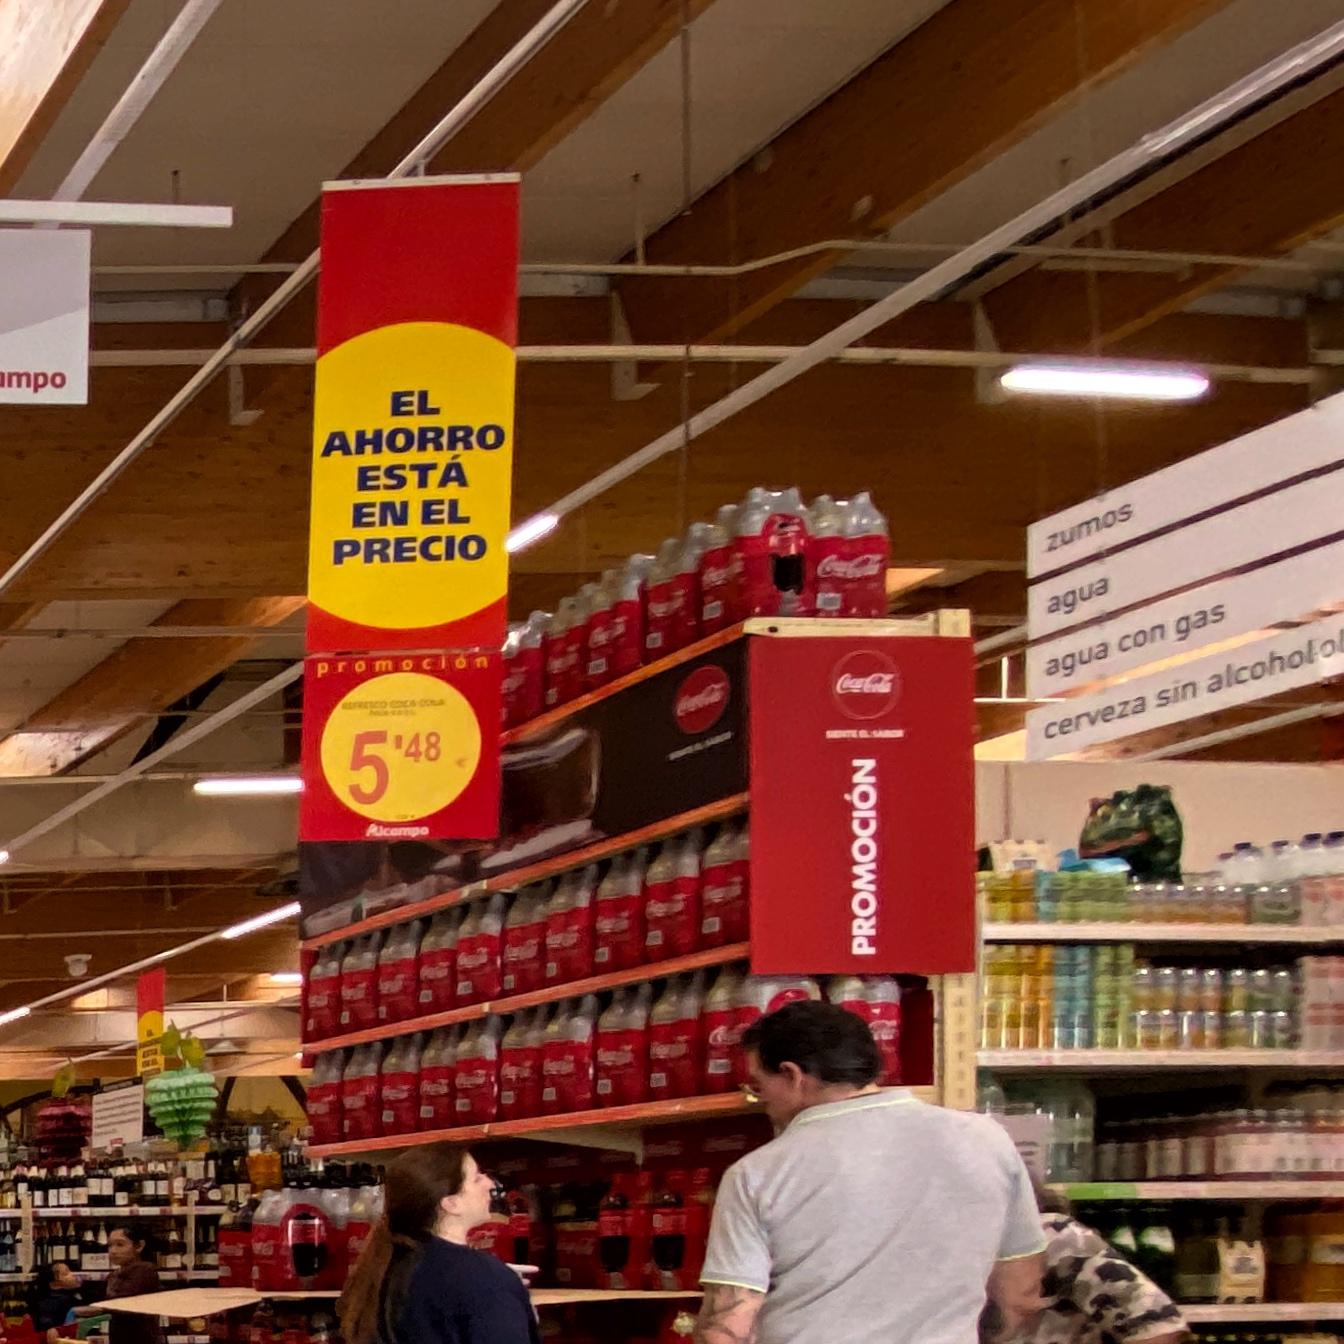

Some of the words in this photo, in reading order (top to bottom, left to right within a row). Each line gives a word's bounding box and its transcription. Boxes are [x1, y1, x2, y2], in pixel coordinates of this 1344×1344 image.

[391, 390, 441, 417] EL
[320, 424, 506, 457] AHORRO
[357, 454, 470, 492] ESTÁ
[352, 500, 409, 529] EN
[421, 499, 471, 525] EL
[1046, 502, 1134, 552] zumos
[333, 534, 488, 566] PRECIO
[1047, 576, 1110, 615] agua
[1046, 640, 1110, 678] agua
[1118, 623, 1165, 653] con
[1176, 603, 1226, 641] gas
[1044, 695, 1147, 740] cerveza
[1156, 678, 1198, 708] sin
[843, 757, 878, 955] PROMOCIÓN
